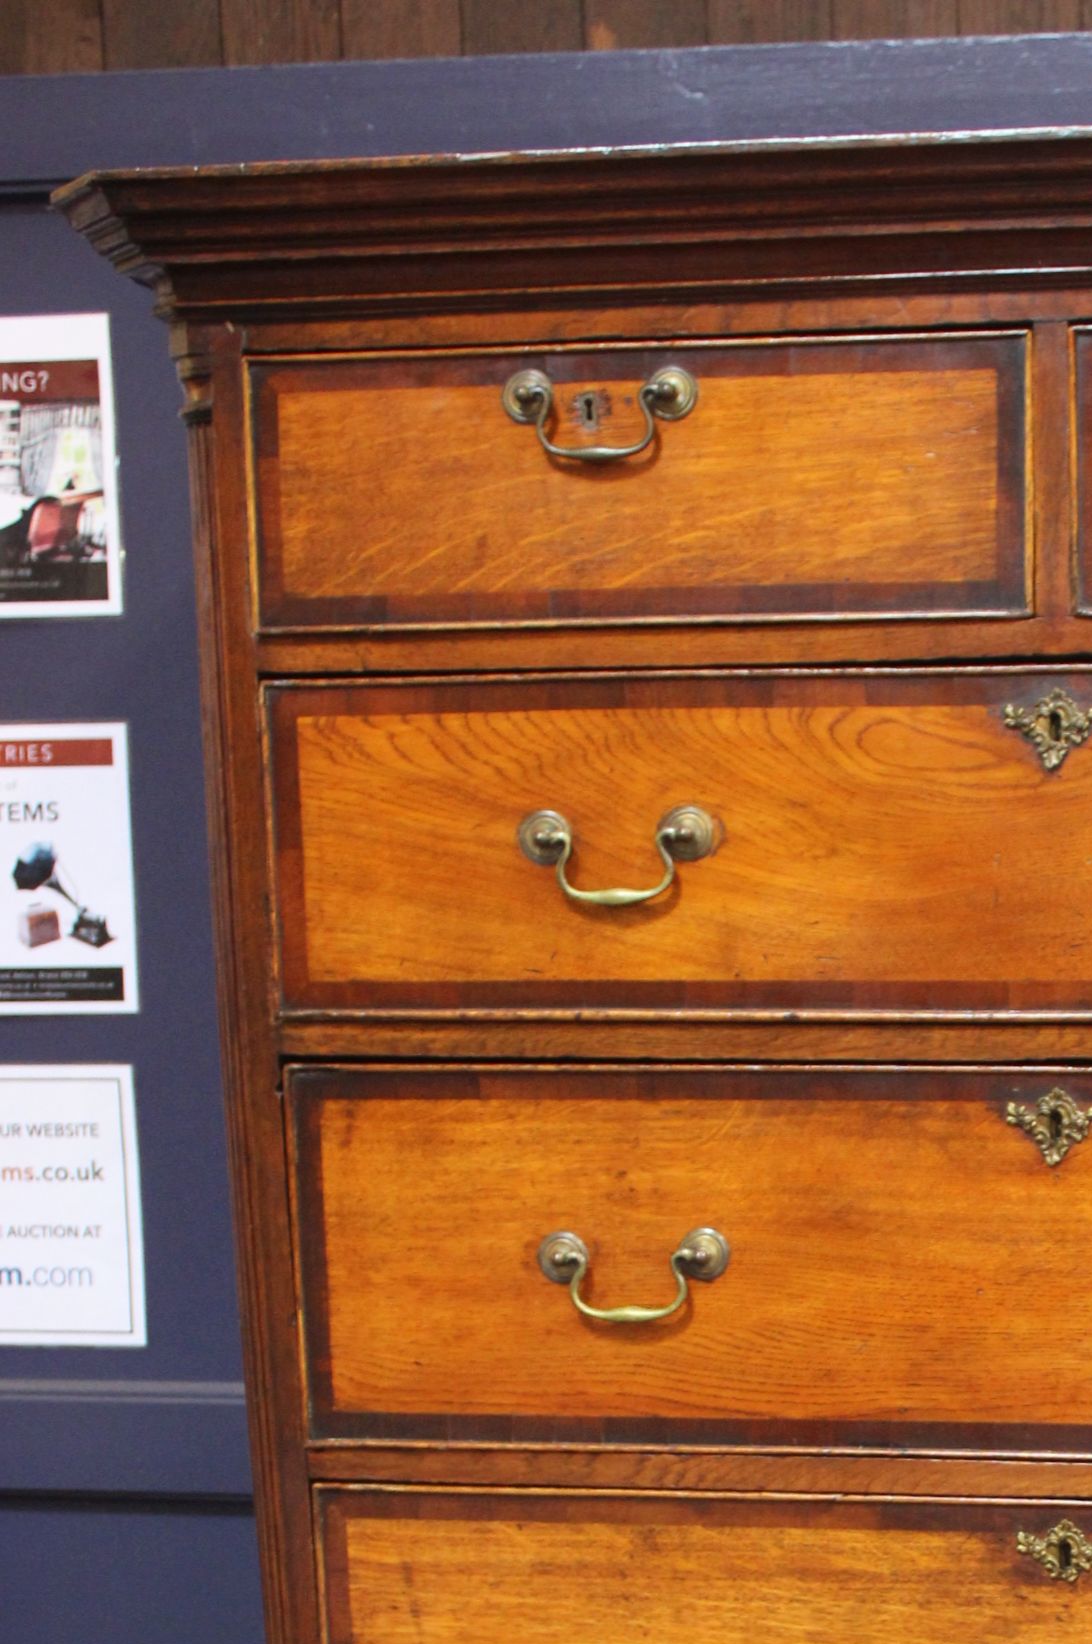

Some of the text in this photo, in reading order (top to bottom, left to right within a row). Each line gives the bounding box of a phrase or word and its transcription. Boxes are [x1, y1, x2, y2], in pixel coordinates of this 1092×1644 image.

[2, 370, 49, 393] NG?
[26, 1122, 99, 1138] WEBSITE
[1, 1159, 104, 1181] ms.co.uk
[7, 1224, 78, 1239] AUCTION
[83, 1224, 102, 1239] AT
[0, 1265, 93, 1287] m.com
